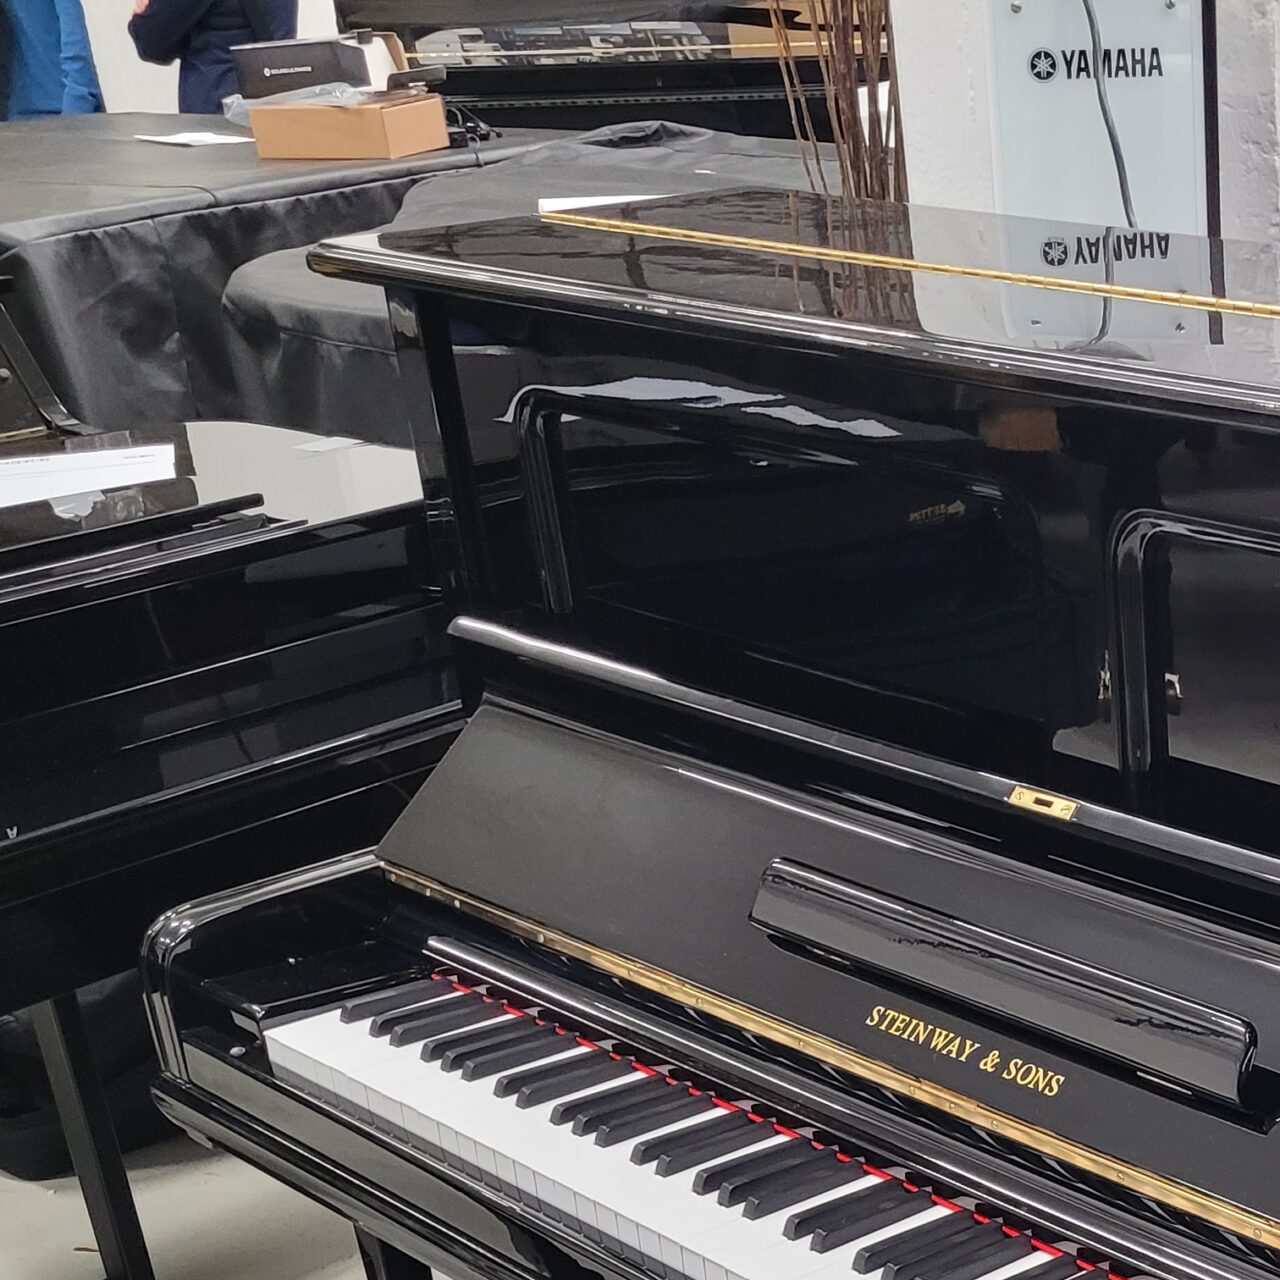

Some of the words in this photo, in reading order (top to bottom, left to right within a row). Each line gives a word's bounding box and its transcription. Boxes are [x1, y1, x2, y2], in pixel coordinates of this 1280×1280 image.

[866, 1006, 980, 1062] STEINWAY
[980, 1050, 1000, 1072] &
[1002, 1058, 1065, 1096] SONS
